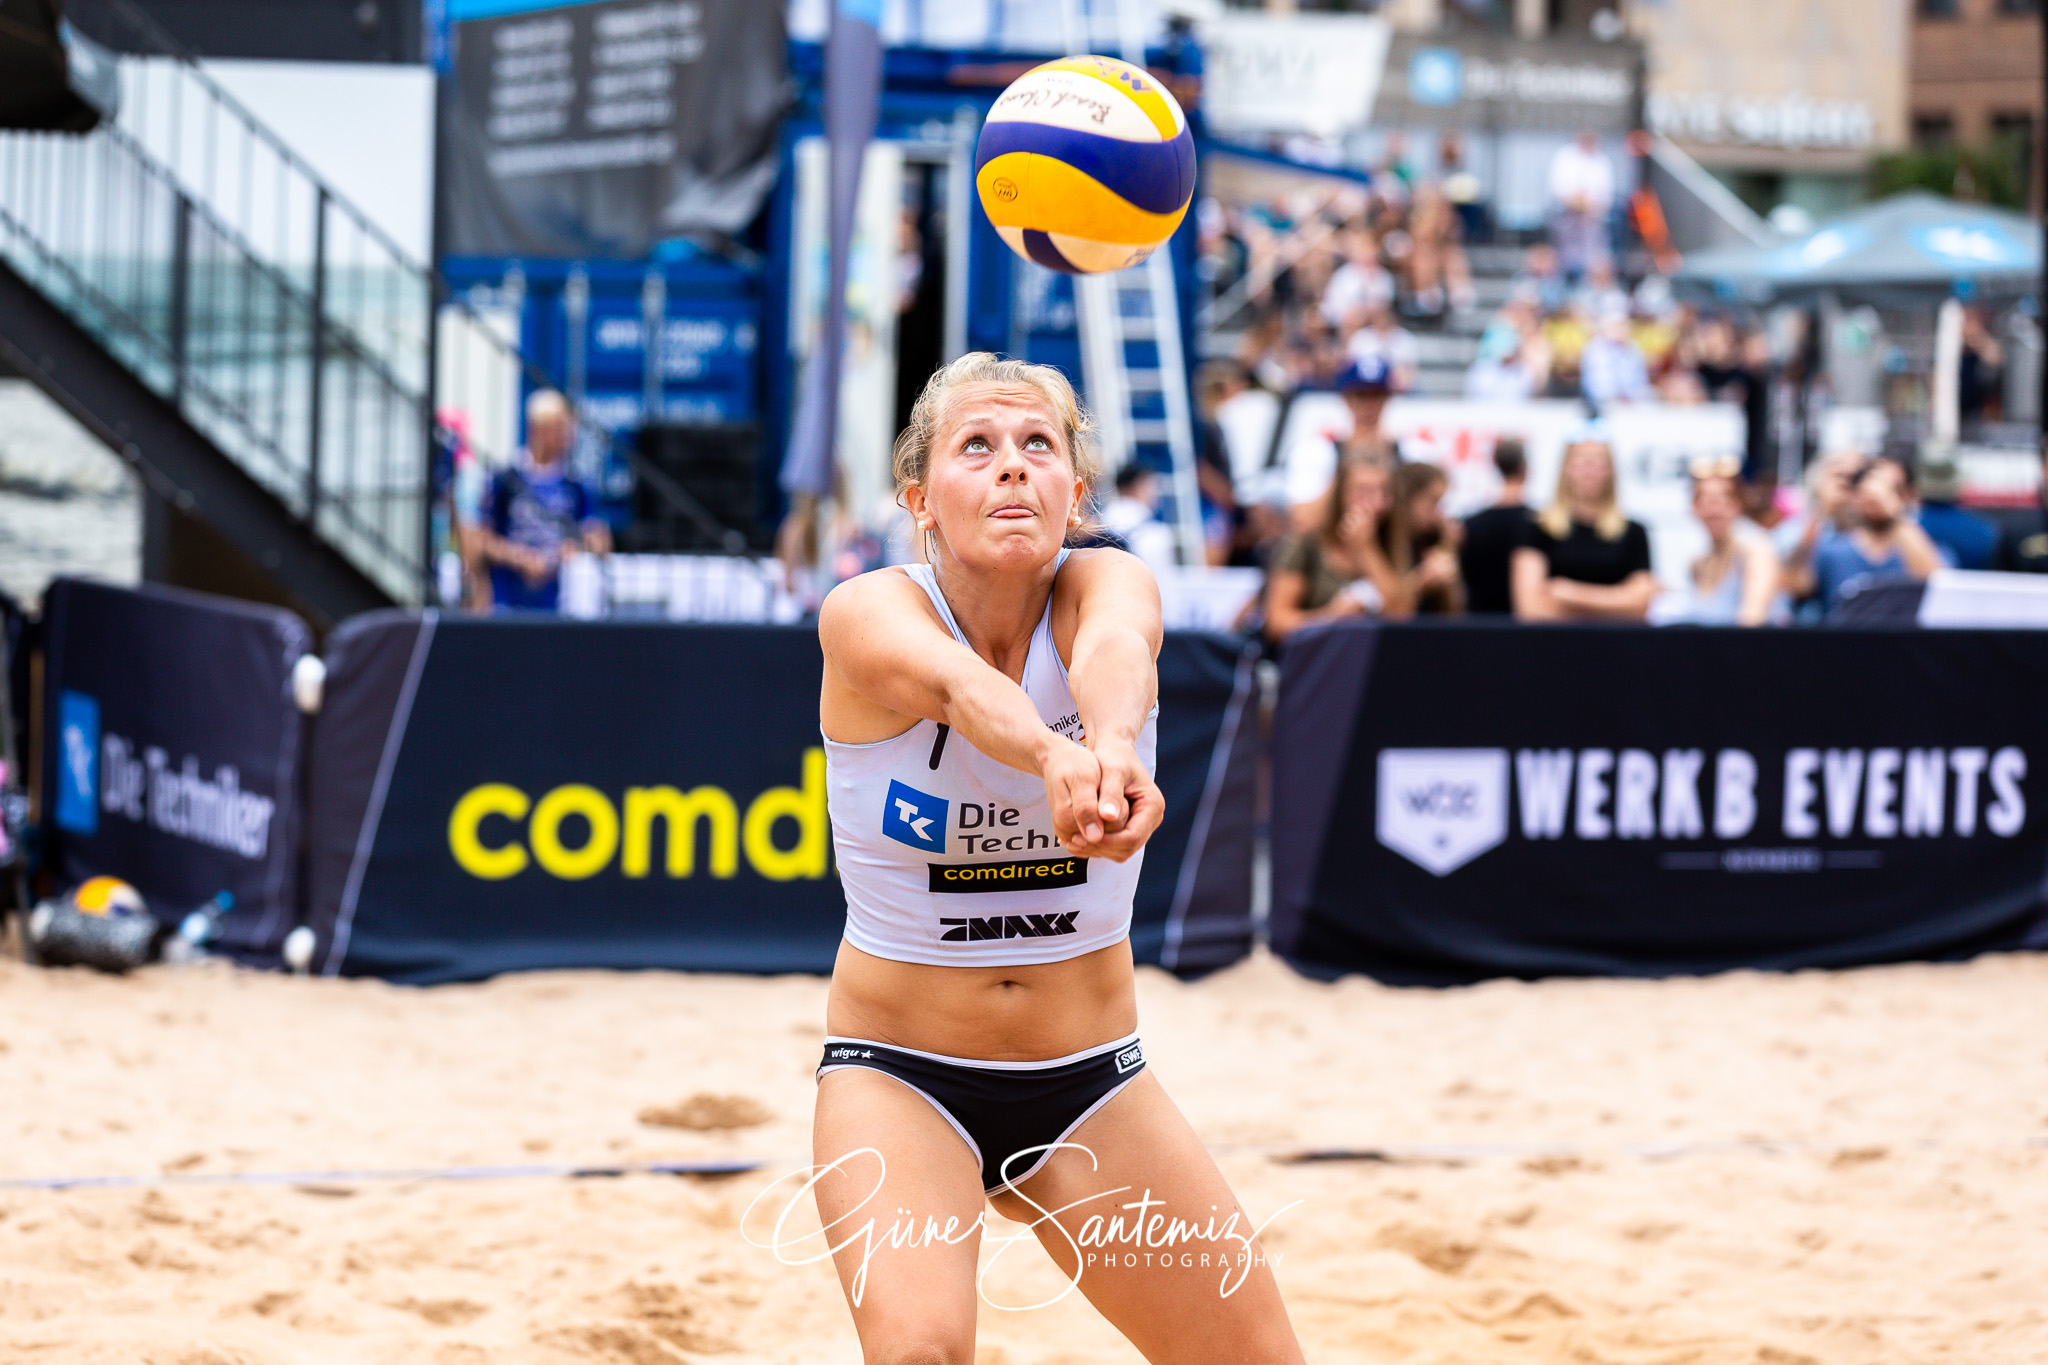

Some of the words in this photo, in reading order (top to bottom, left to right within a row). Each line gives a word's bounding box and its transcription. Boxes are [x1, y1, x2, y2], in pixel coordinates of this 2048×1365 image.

[448, 746, 829, 880] comd
[959, 802, 1020, 829] Die
[1782, 746, 2028, 840] EVENTS
[943, 860, 1076, 881] comdirect
